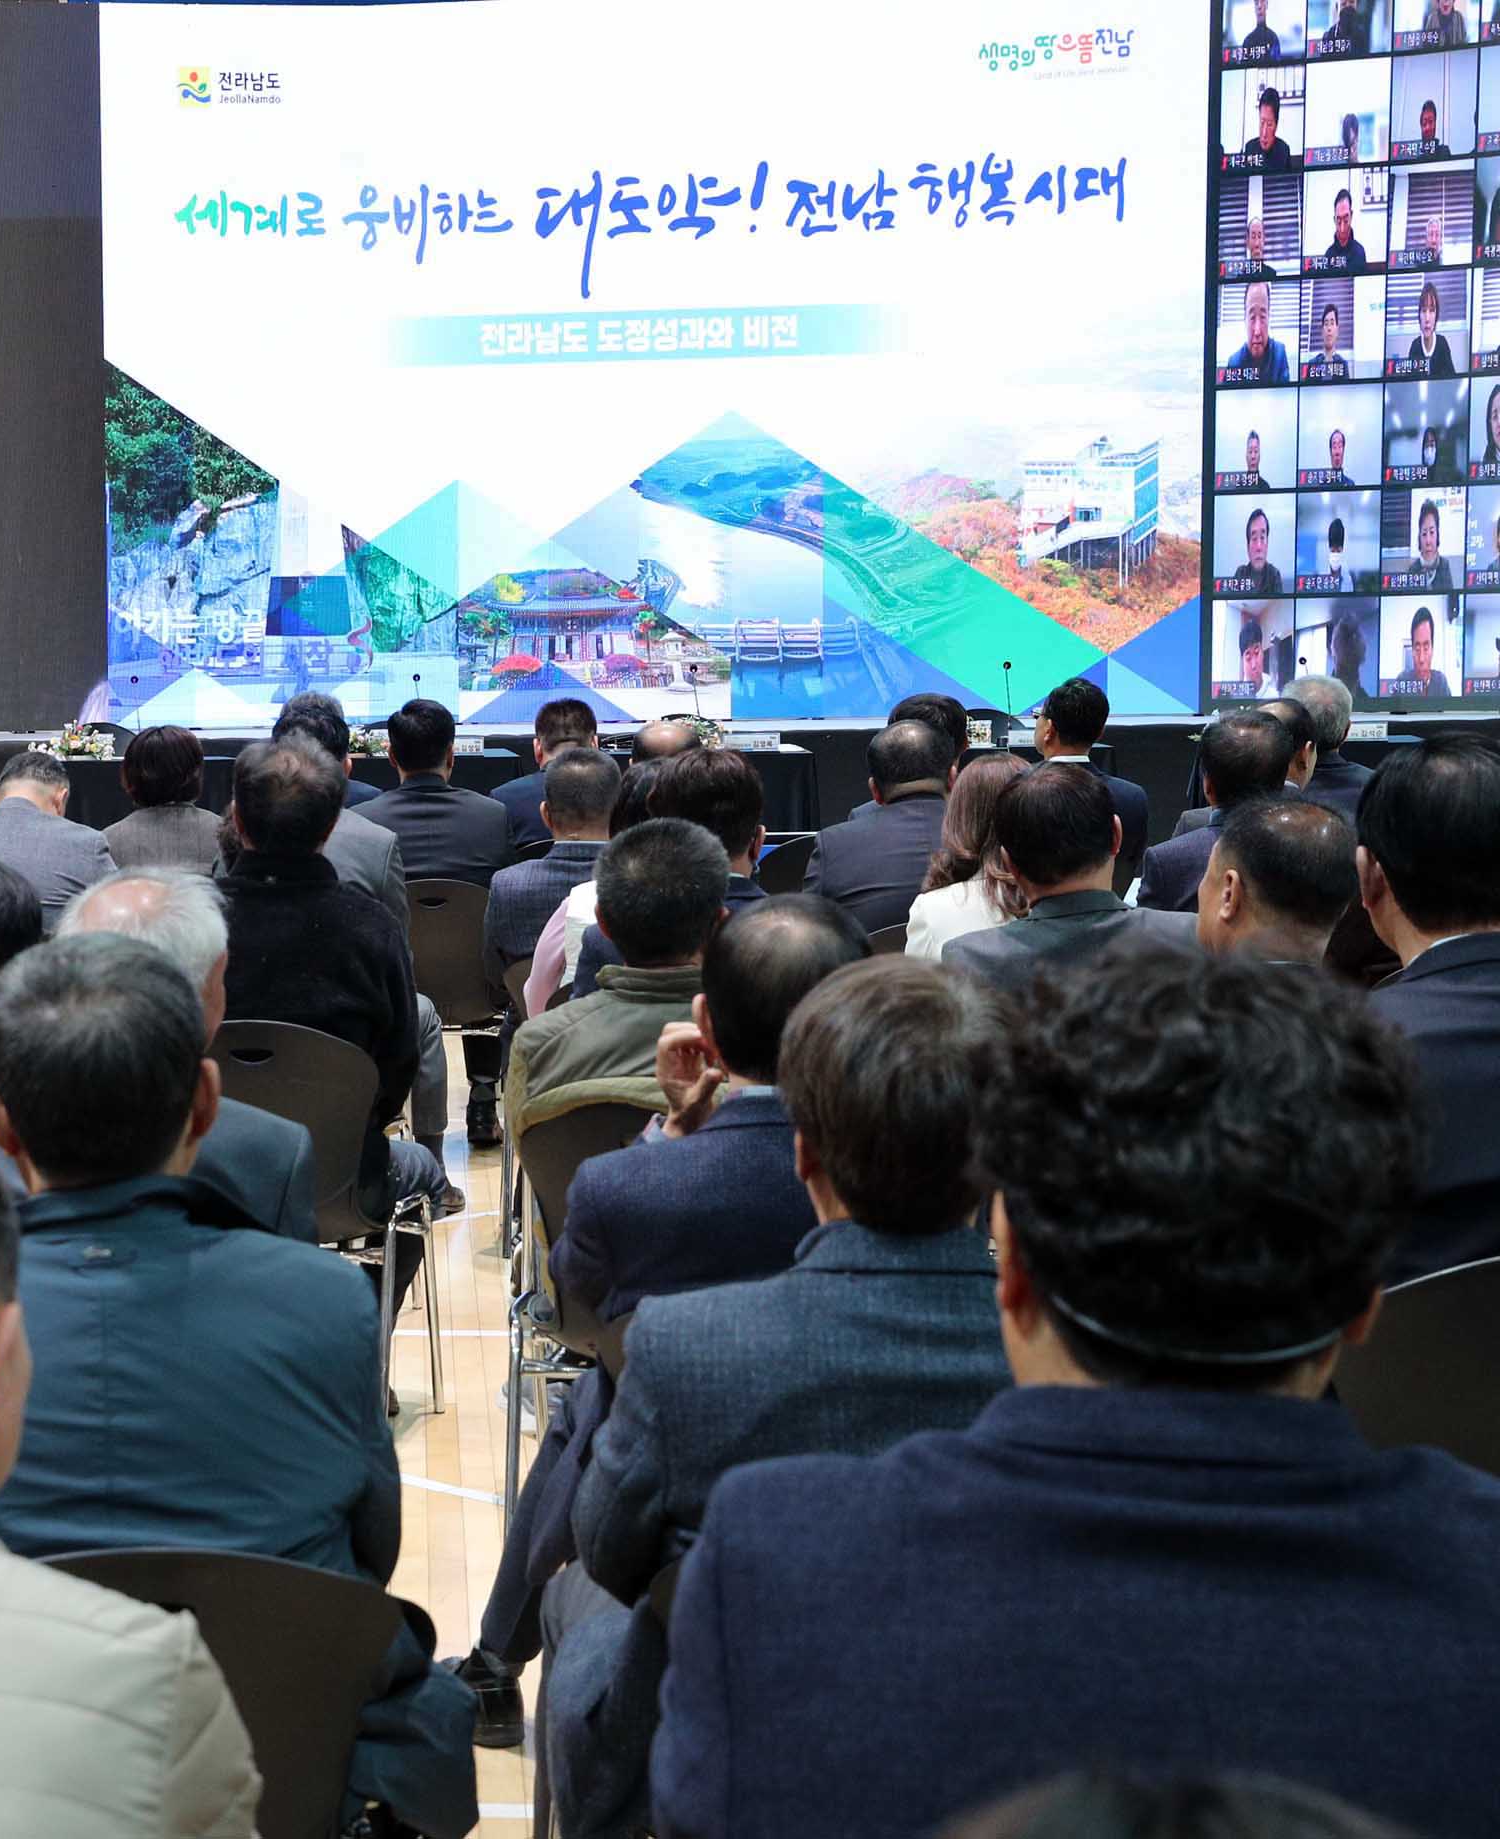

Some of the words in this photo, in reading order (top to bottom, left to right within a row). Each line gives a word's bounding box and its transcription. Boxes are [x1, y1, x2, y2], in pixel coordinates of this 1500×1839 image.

[218, 72, 281, 92] 전라남도
[219, 95, 281, 104] JeollaNamdo
[174, 190, 326, 238] 세계로
[342, 184, 514, 265] 웅비하는
[786, 168, 899, 237] 전남
[1024, 157, 1128, 223] 시대
[479, 320, 590, 356] 전라남도
[596, 316, 734, 353] 도정성과와
[742, 313, 799, 348] 비전
